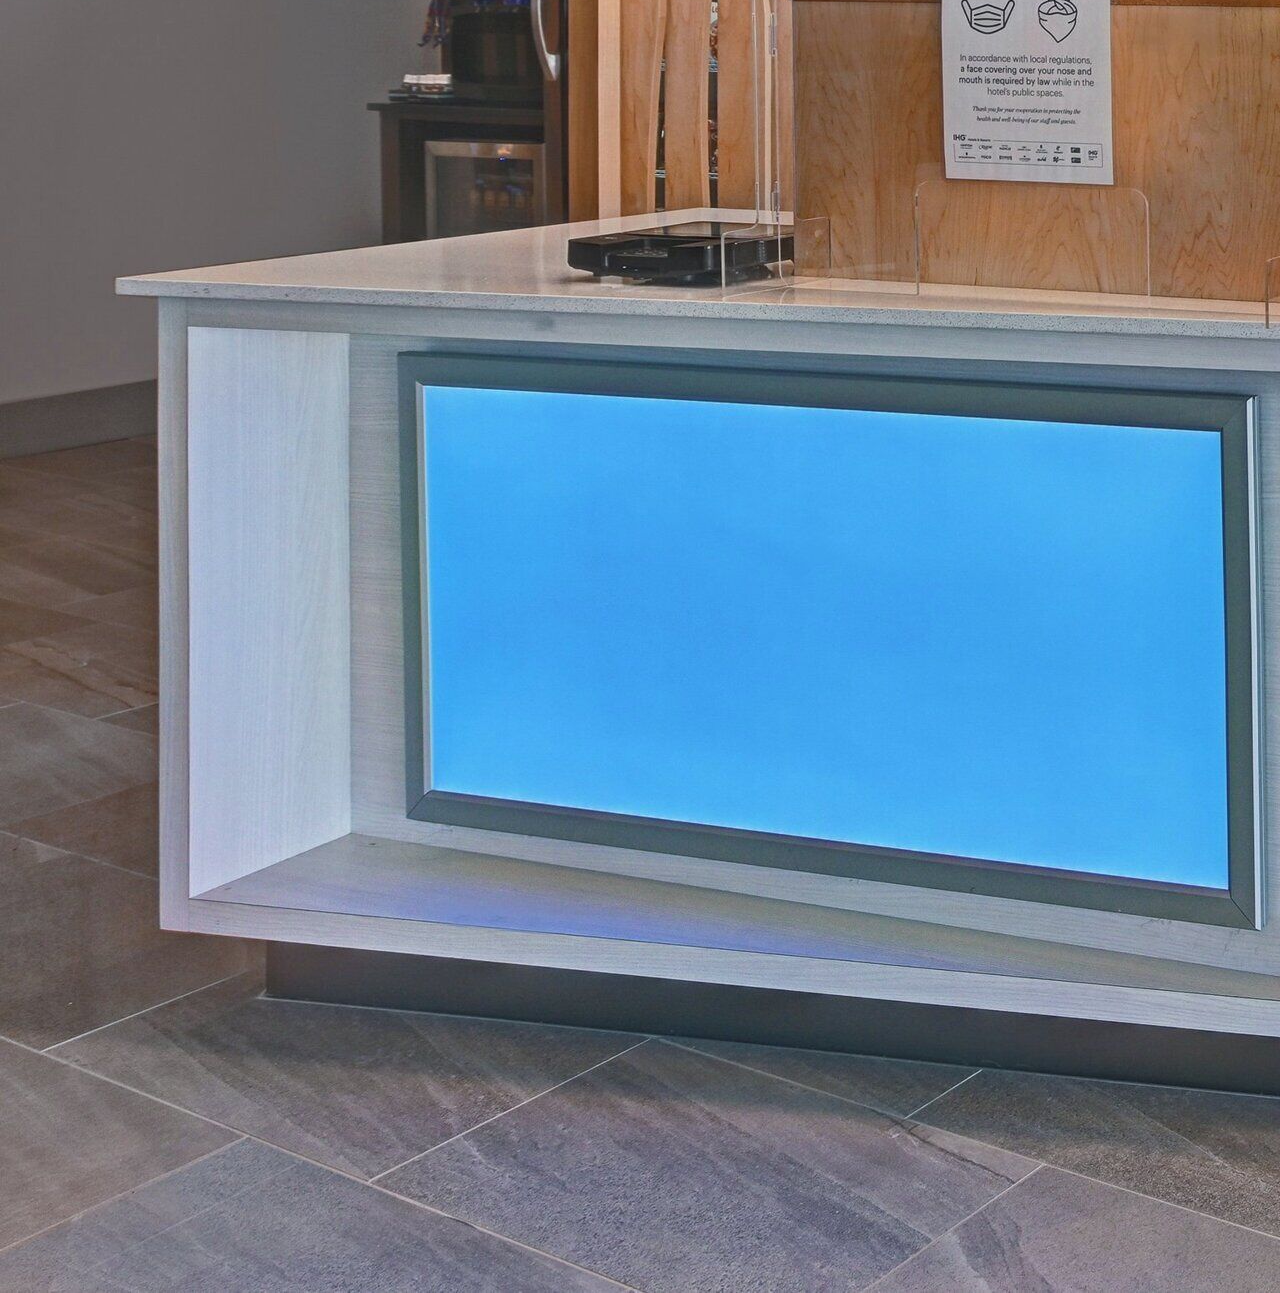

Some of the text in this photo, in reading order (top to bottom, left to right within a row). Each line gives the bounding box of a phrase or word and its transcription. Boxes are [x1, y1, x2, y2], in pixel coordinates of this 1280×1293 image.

[1049, 56, 1092, 65] regulations,
[967, 65, 982, 73] face
[985, 66, 1016, 75] covering
[959, 76, 982, 84] mouth
[993, 77, 1024, 86] required
[1026, 78, 1035, 87] by
[1052, 78, 1071, 86] while
[1012, 89, 1034, 98] public
